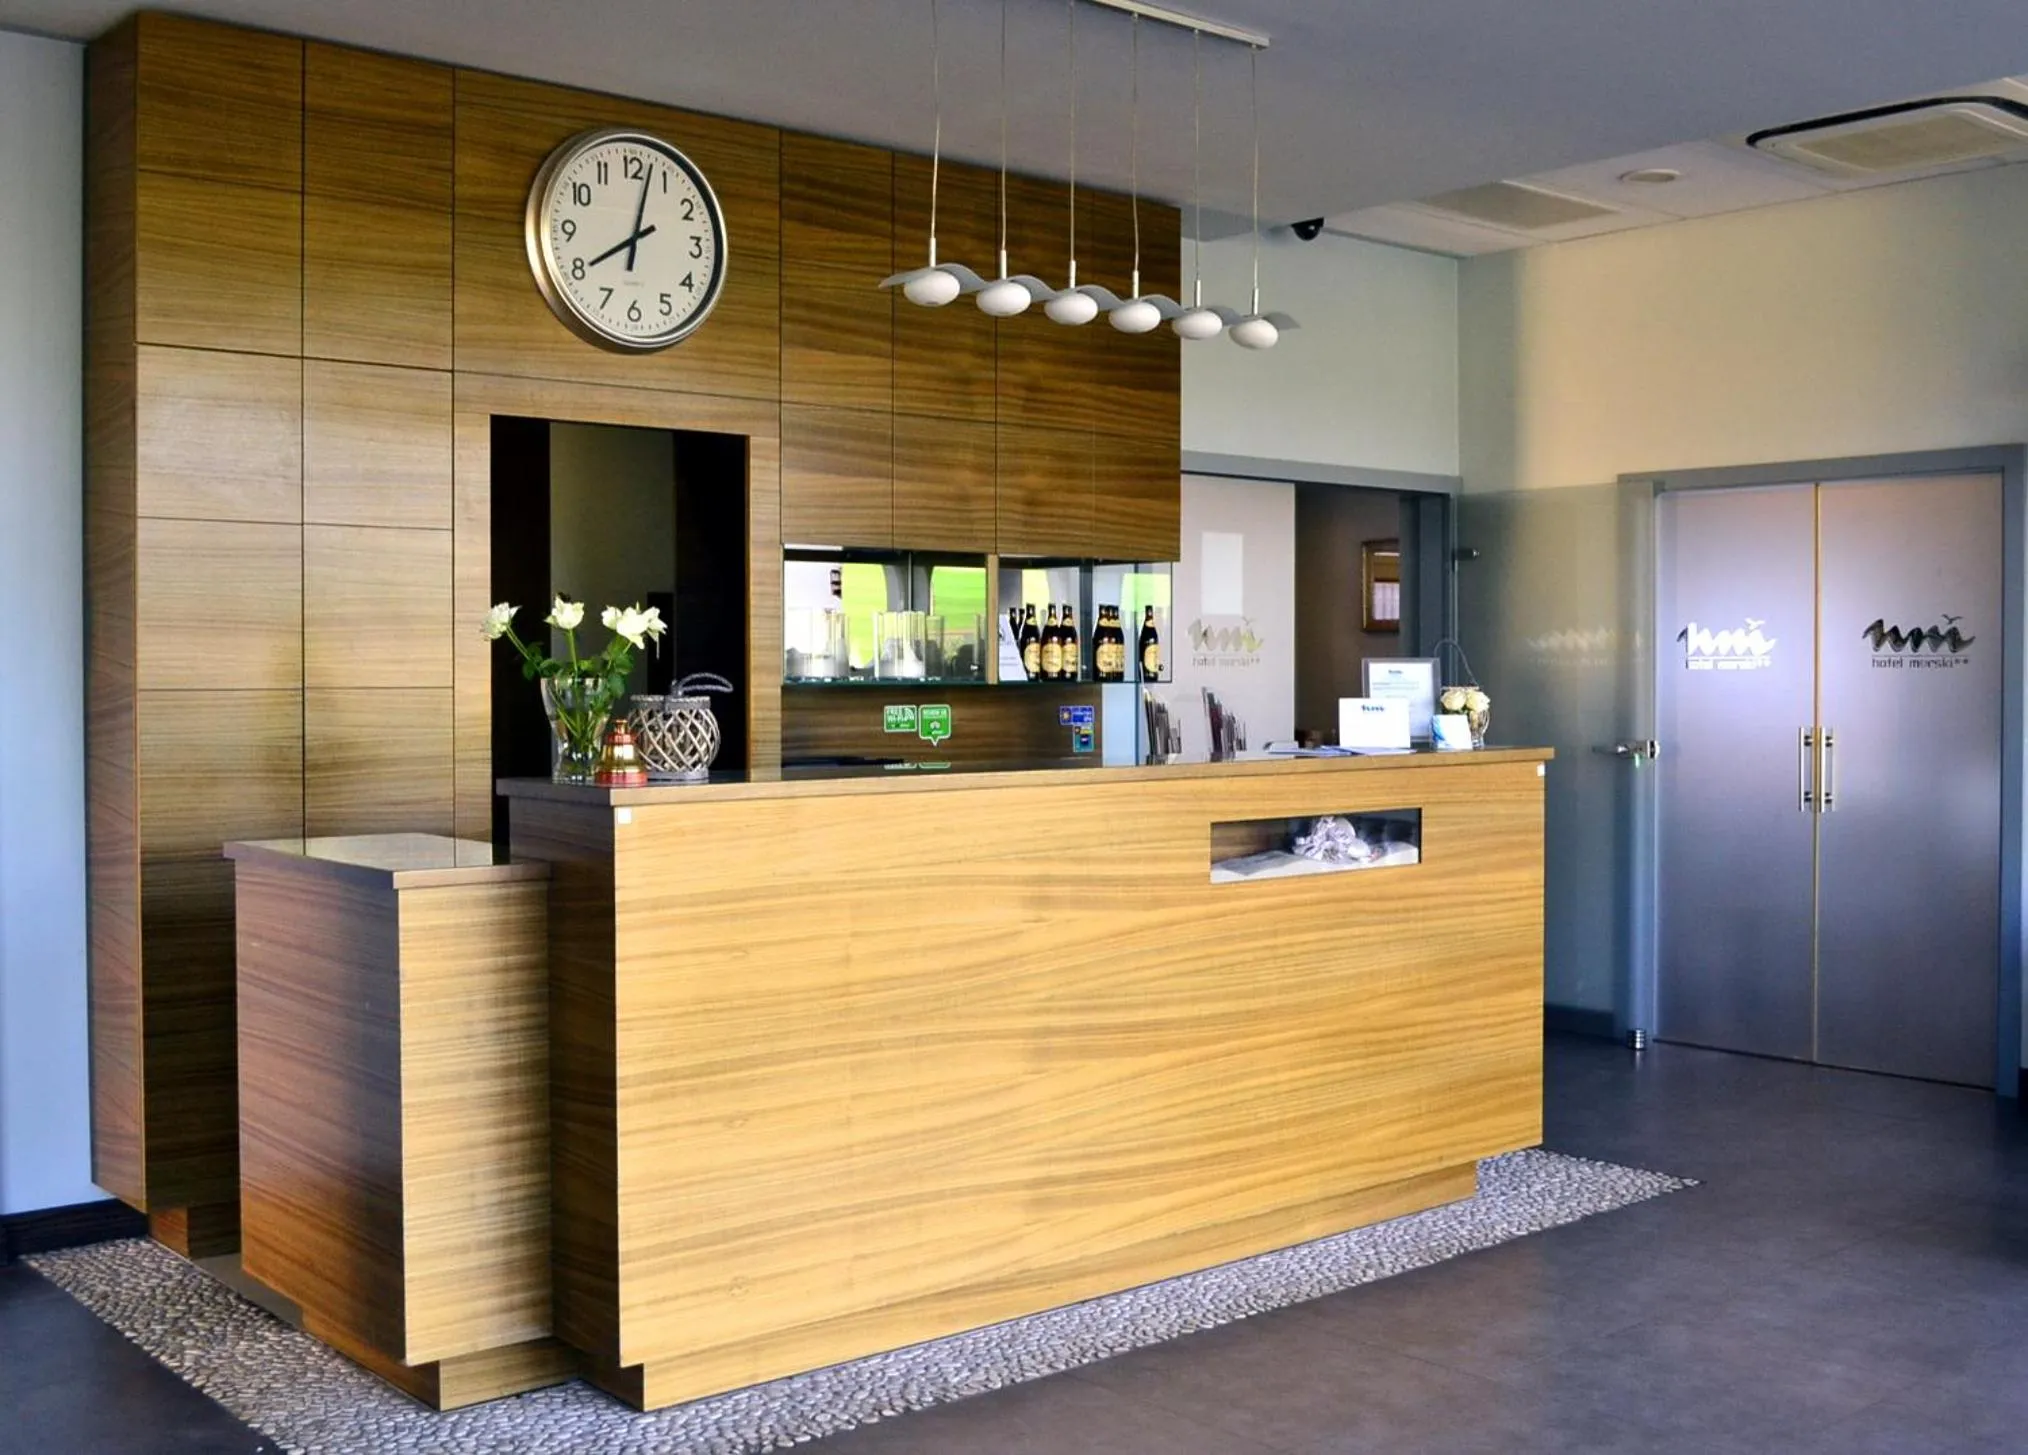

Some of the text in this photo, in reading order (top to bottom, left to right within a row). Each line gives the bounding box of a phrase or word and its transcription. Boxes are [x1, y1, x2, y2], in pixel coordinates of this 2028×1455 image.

[597, 161, 608, 185] 11
[623, 154, 644, 180] 12
[573, 182, 591, 206] 10
[661, 170, 668, 195] 1
[681, 197, 694, 221] 2
[562, 220, 576, 242] 9
[689, 235, 703, 260] 3
[572, 258, 585, 280] 8
[678, 271, 695, 294] 4
[600, 288, 613, 309] 7
[660, 293, 671, 315] 5
[628, 301, 641, 322] 6
